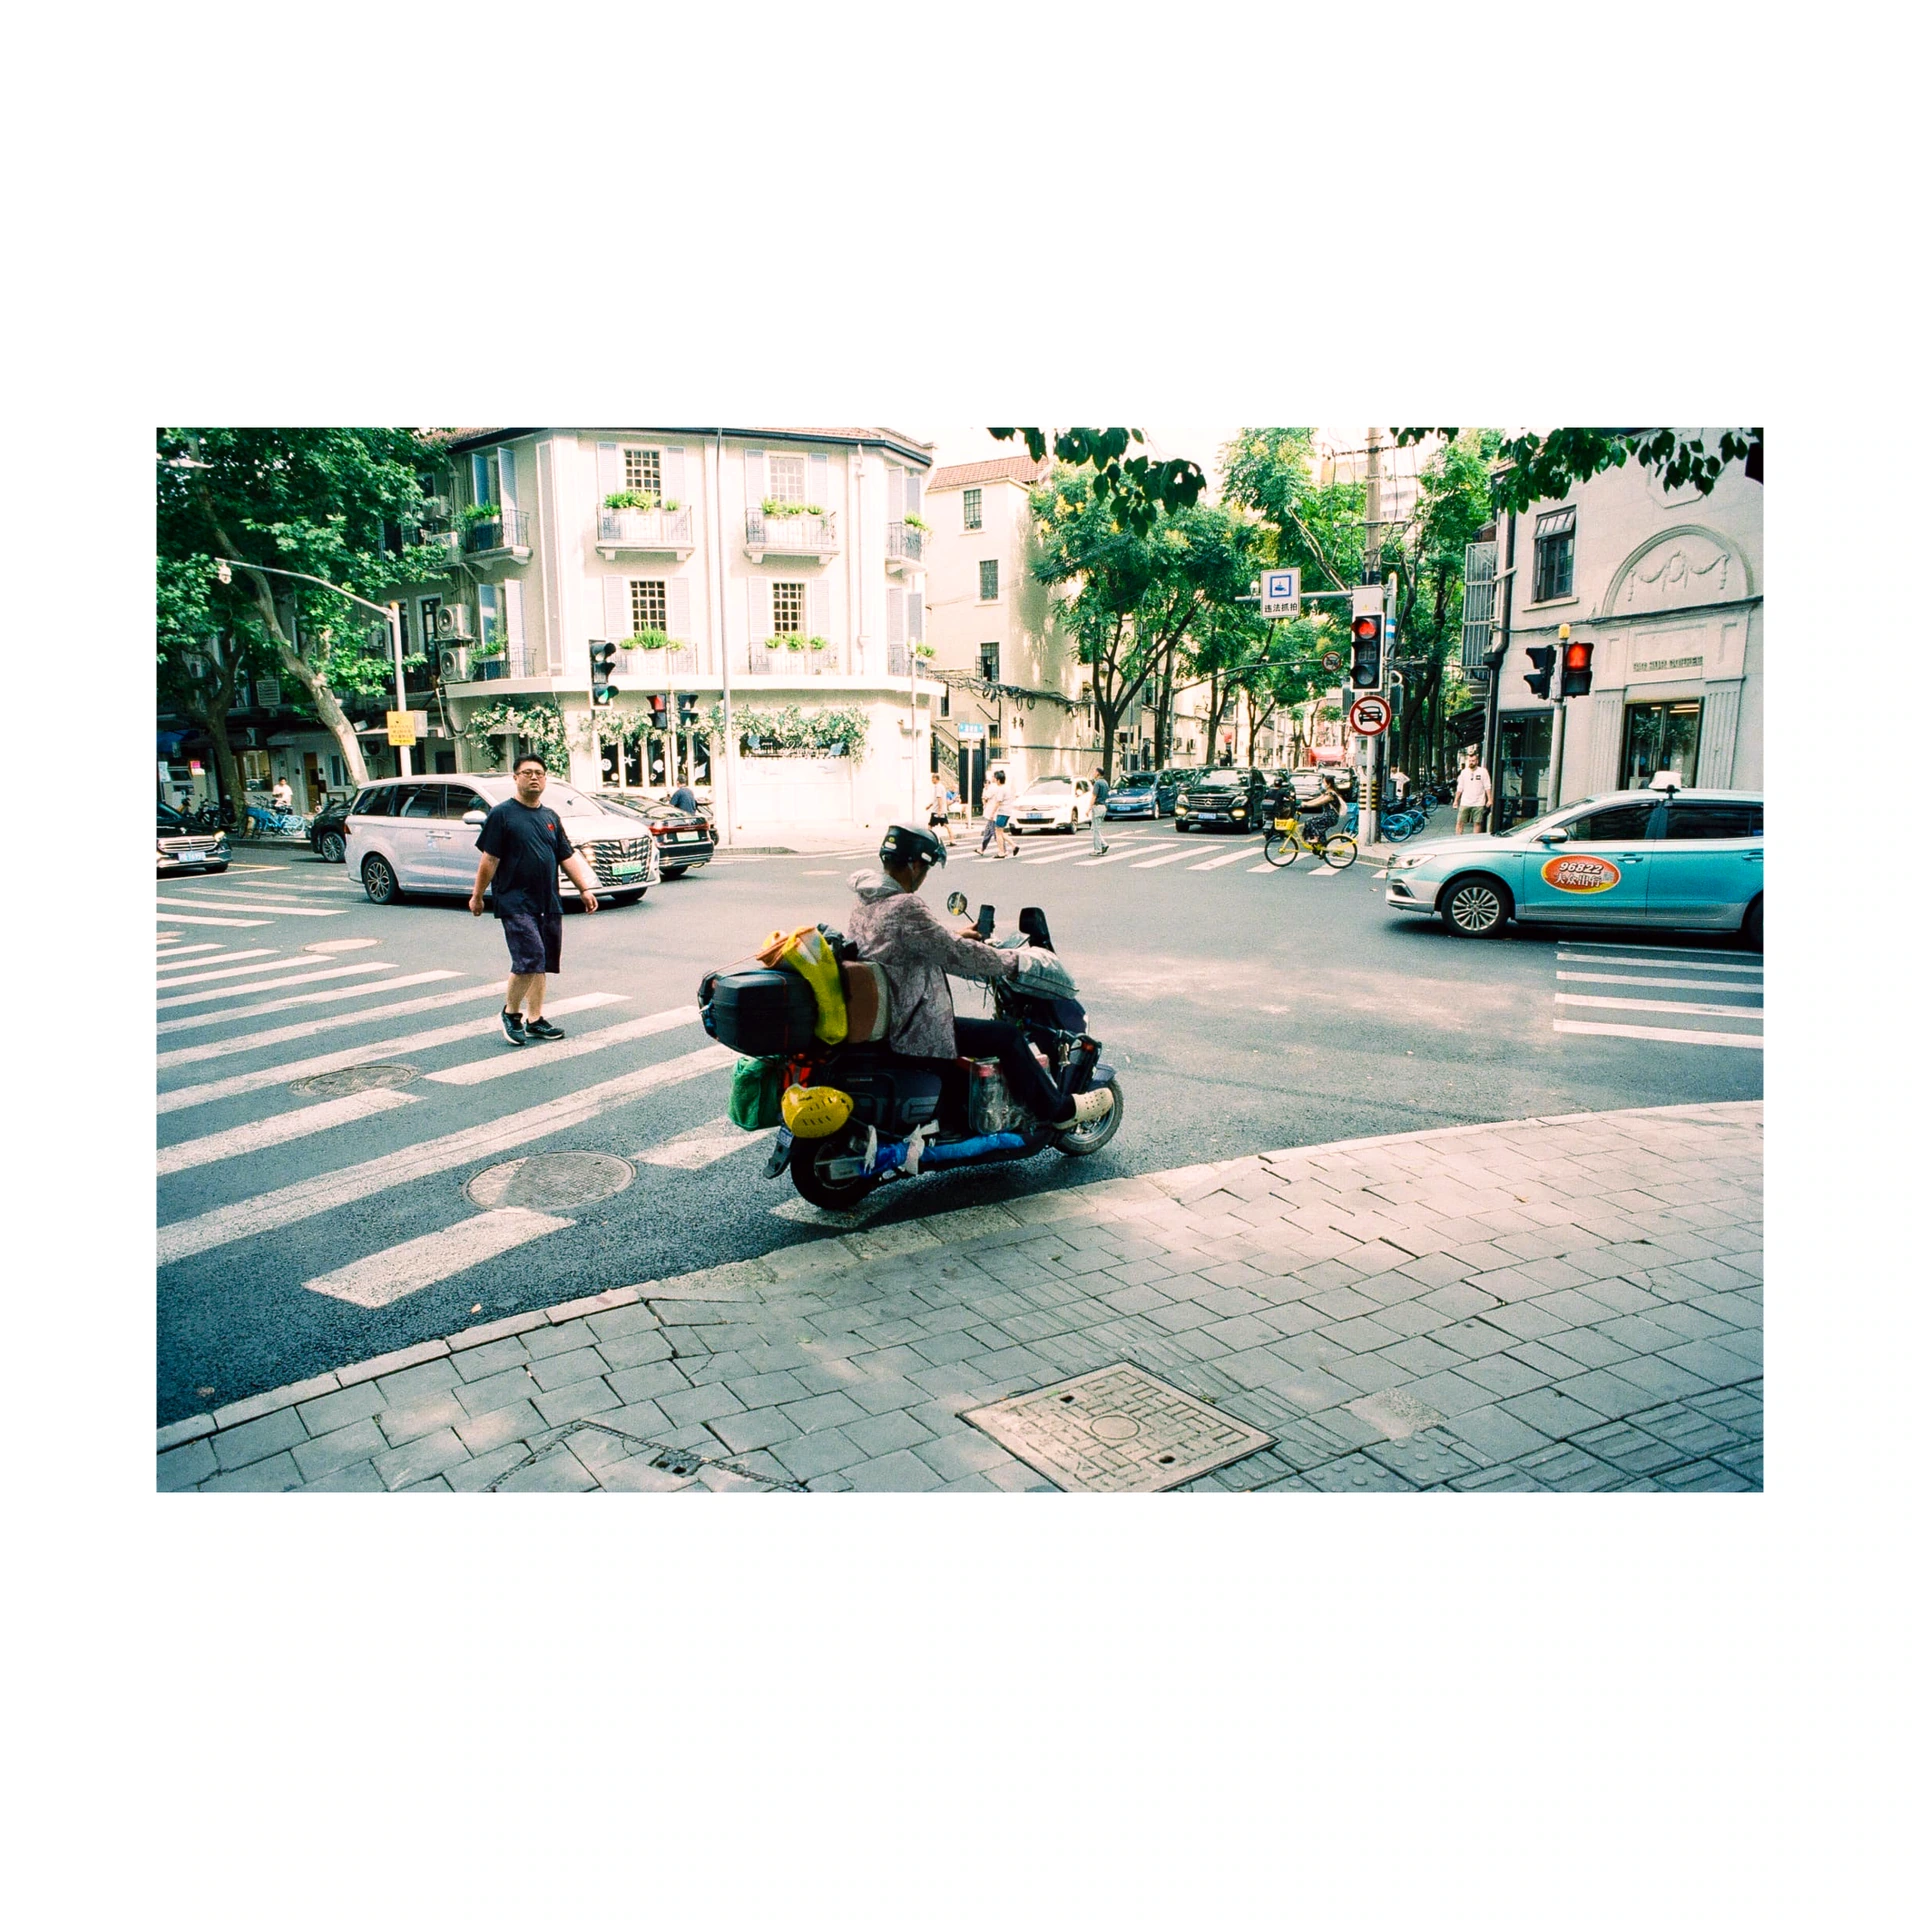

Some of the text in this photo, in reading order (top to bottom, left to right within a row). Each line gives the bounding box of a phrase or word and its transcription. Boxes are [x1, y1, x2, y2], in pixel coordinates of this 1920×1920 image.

[1264, 602, 1298, 613] 违法抓拍
[1559, 861, 1604, 874] 96822
[1554, 873, 1601, 887] 大众出行
